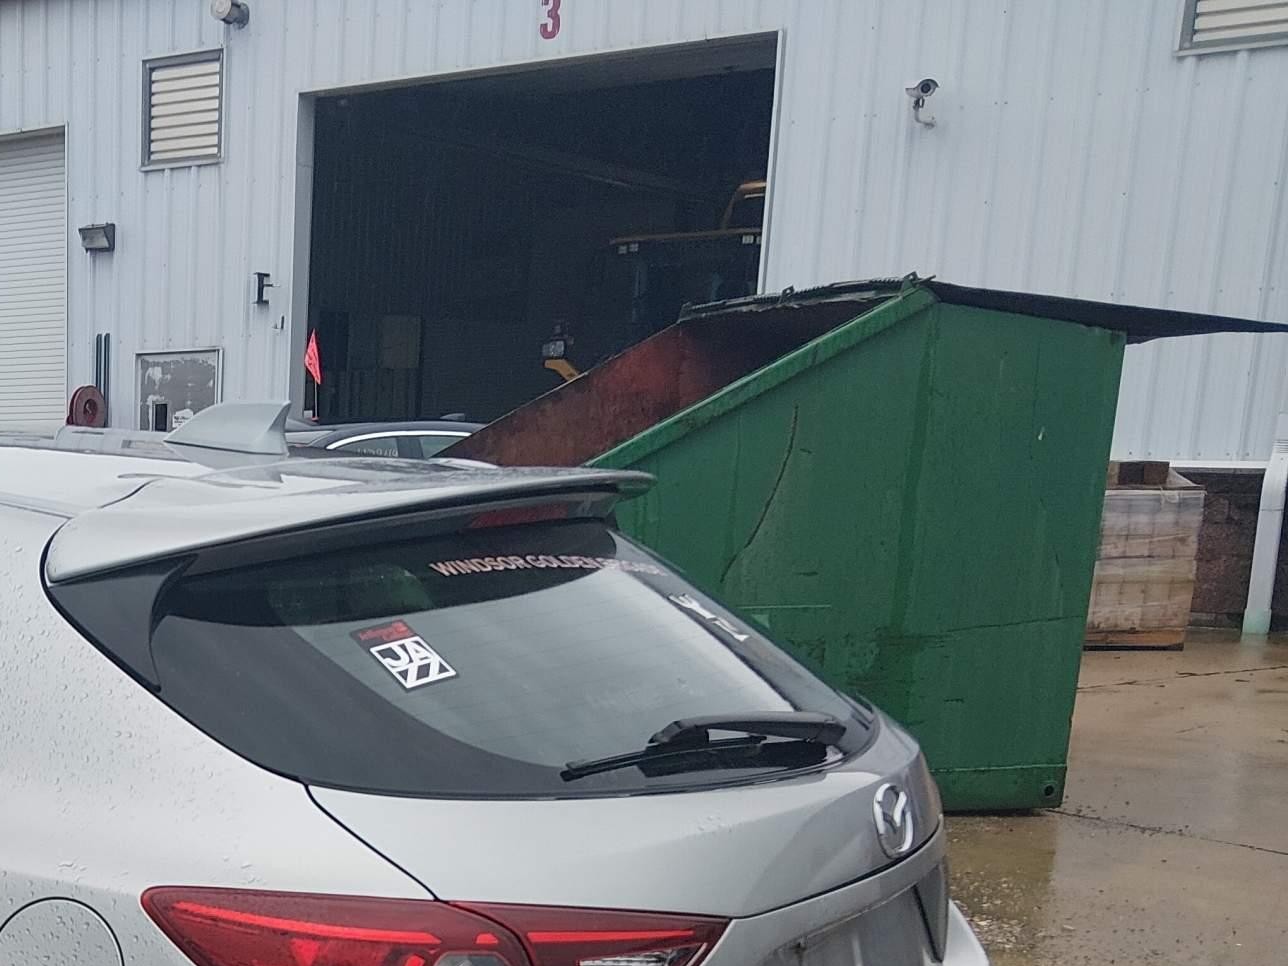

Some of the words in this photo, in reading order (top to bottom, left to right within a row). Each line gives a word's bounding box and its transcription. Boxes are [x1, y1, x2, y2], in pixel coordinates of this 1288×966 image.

[540, 0, 561, 40] 3
[428, 556, 532, 577] WINDSOR
[525, 555, 603, 569] GOLDEN
